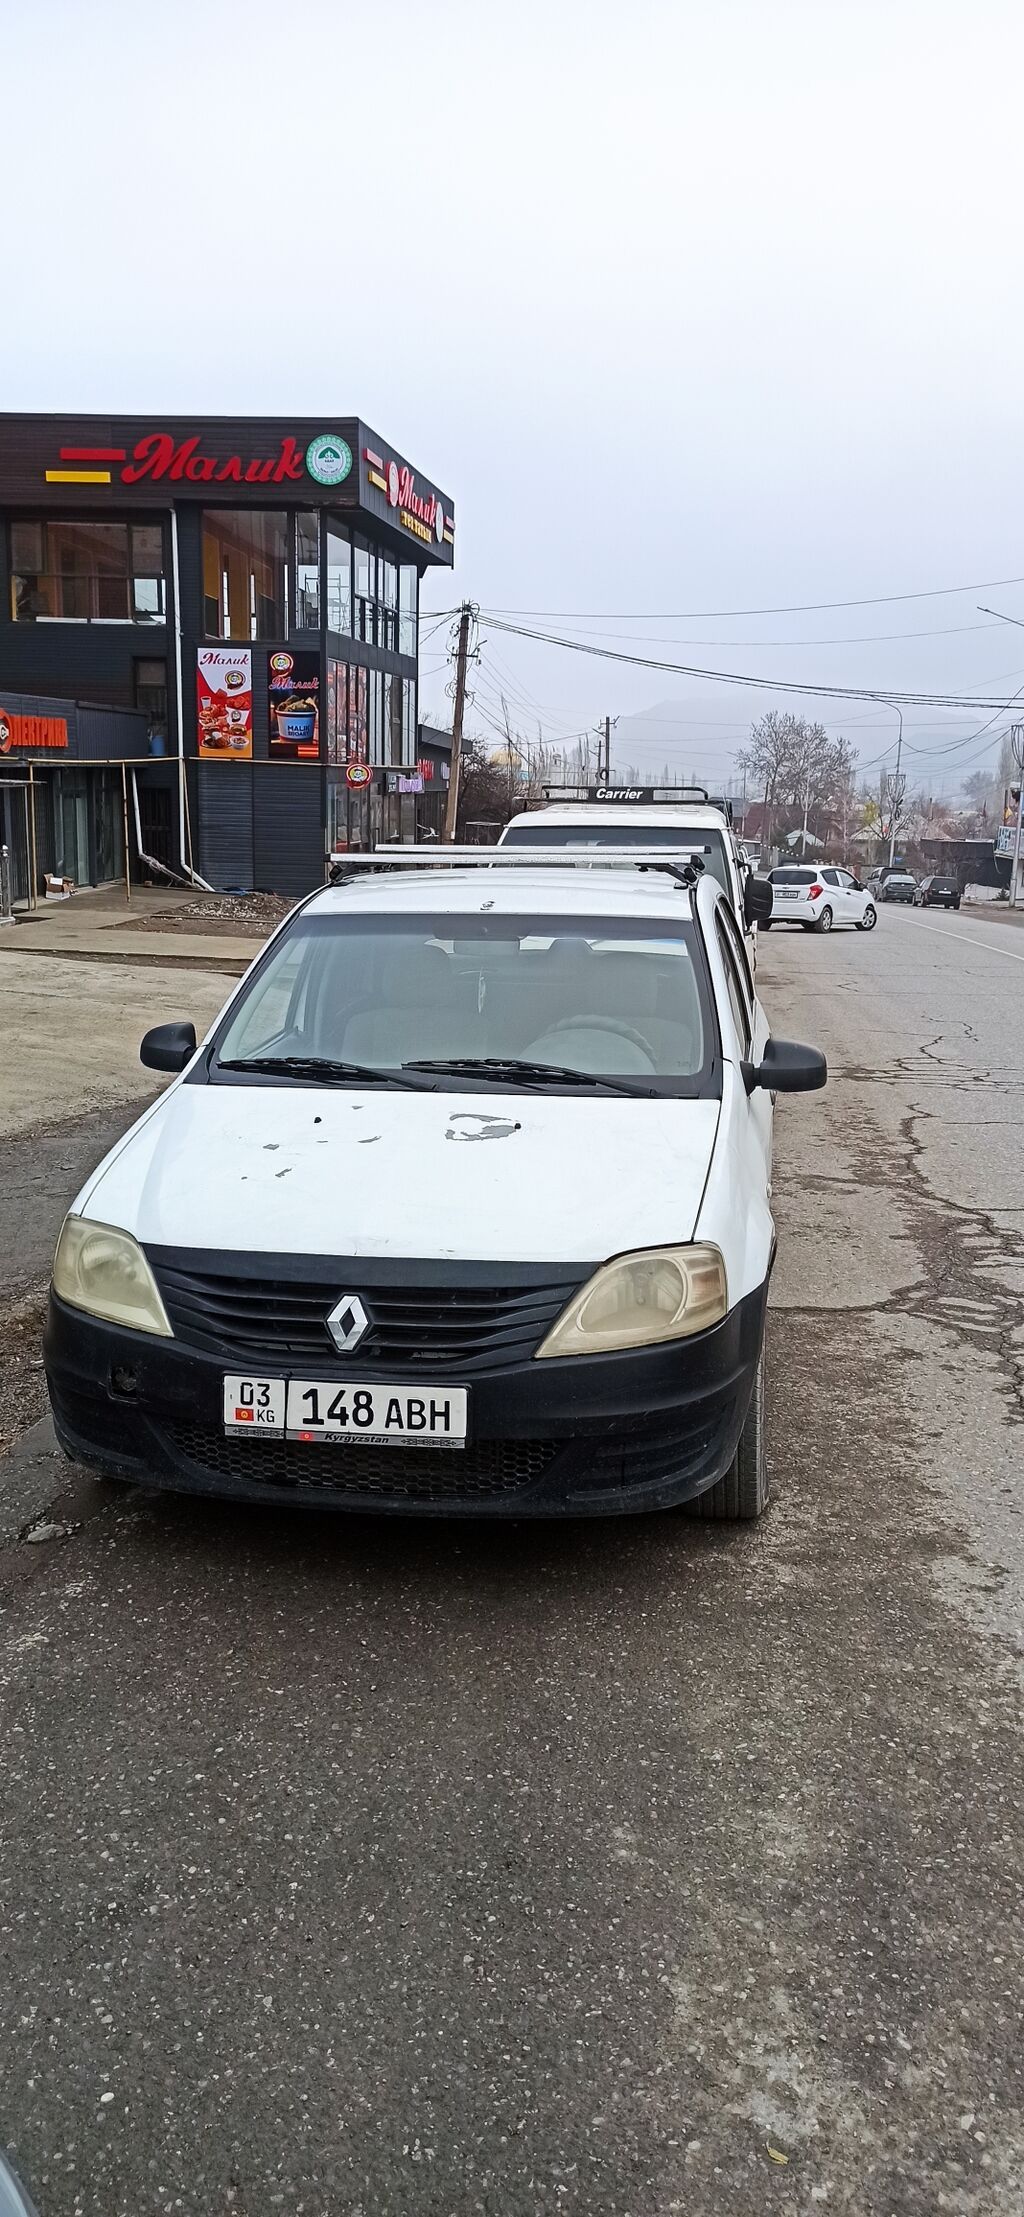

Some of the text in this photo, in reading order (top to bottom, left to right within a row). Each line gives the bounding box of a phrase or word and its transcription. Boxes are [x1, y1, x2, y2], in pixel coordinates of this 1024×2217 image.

[120, 432, 304, 484] Малик
[398, 466, 436, 528] Малик
[199, 652, 250, 666] Малик
[596, 788, 643, 799] Carrier
[239, 1382, 451, 1432] 03 148 ABH
[256, 1409, 275, 1423] KG
[324, 1432, 390, 1445] Kyrgyzstan
